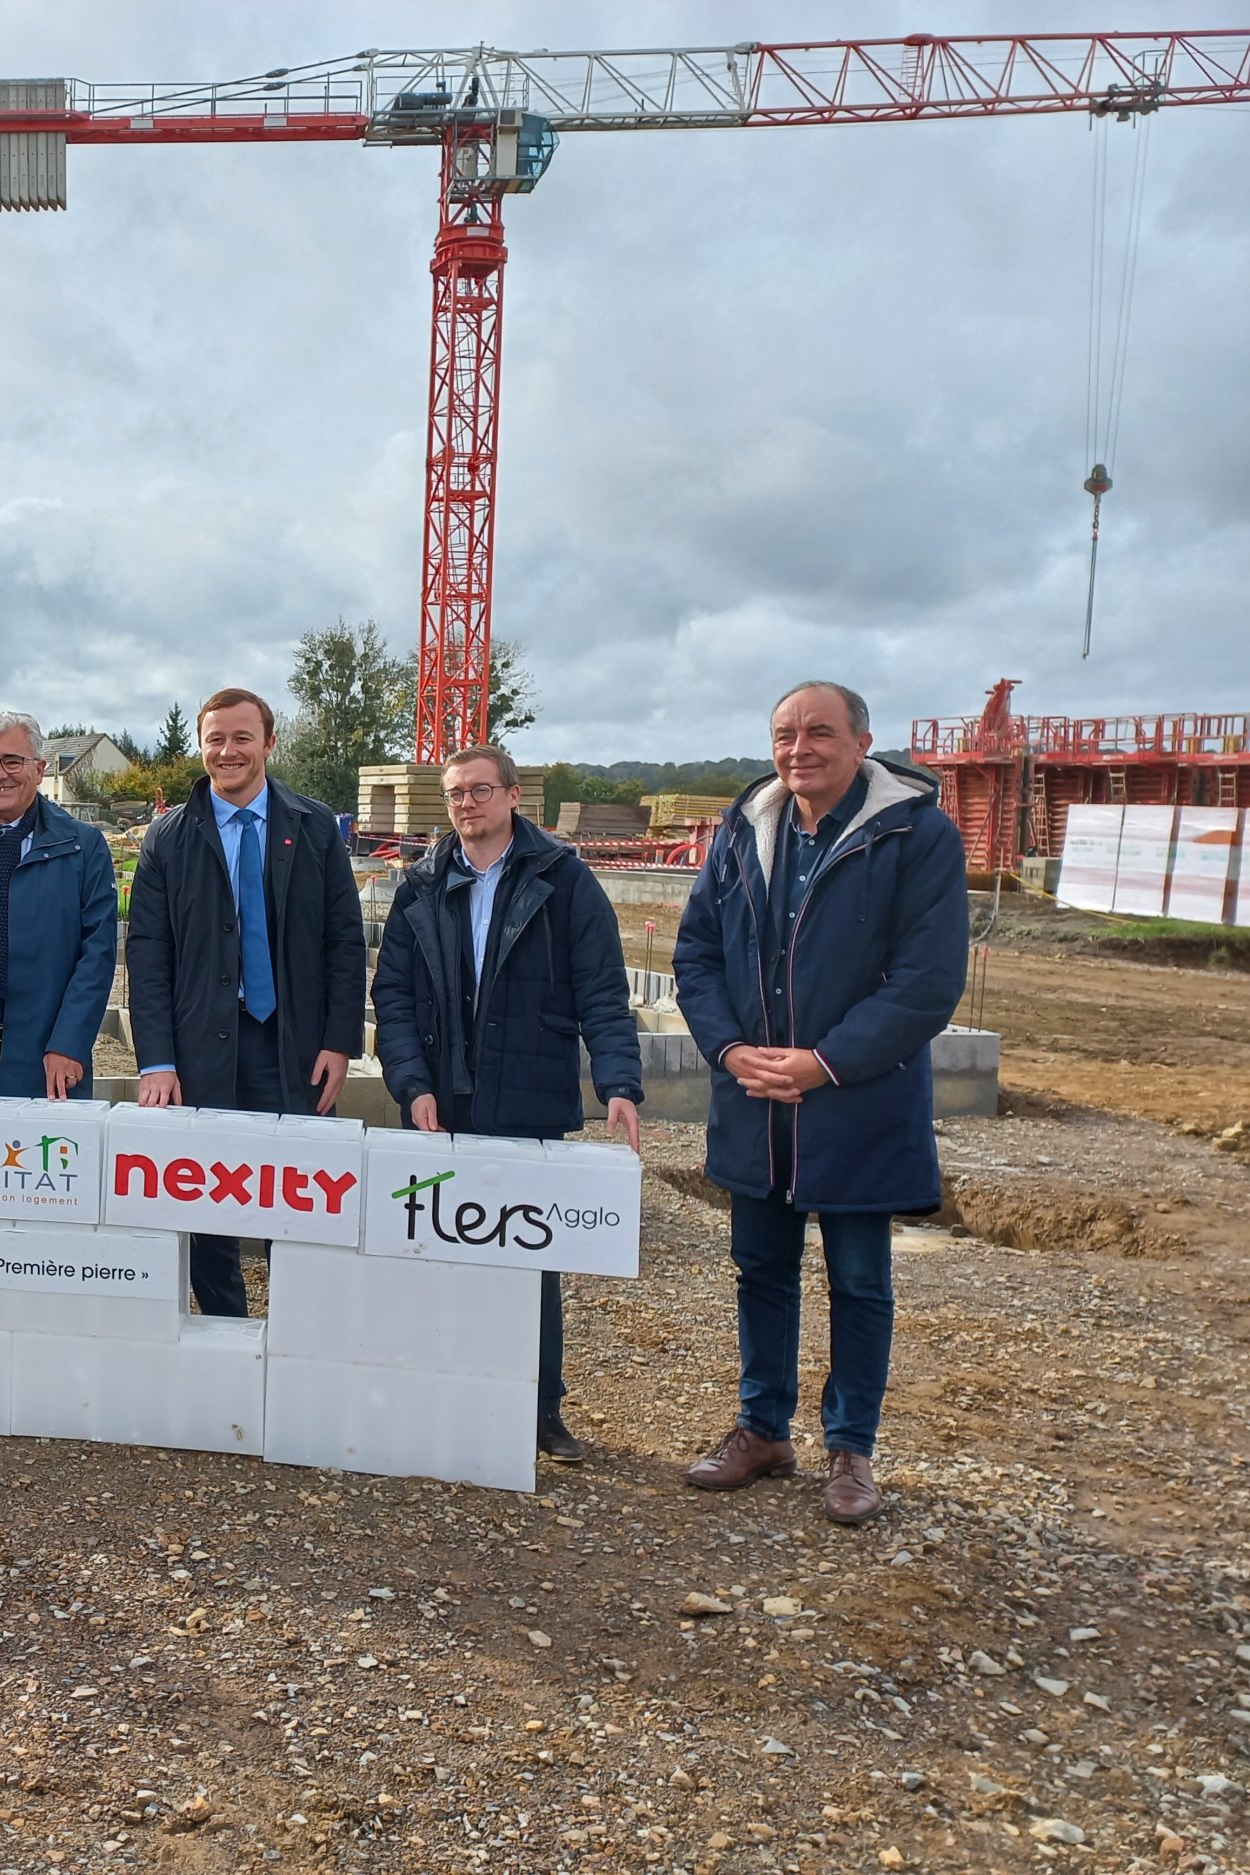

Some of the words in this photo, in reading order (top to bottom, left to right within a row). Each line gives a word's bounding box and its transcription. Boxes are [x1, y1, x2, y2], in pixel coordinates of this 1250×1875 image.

[21, 1195, 79, 1206] logement
[545, 1202, 620, 1230] Agglo
[82, 1264, 136, 1282] pierre
